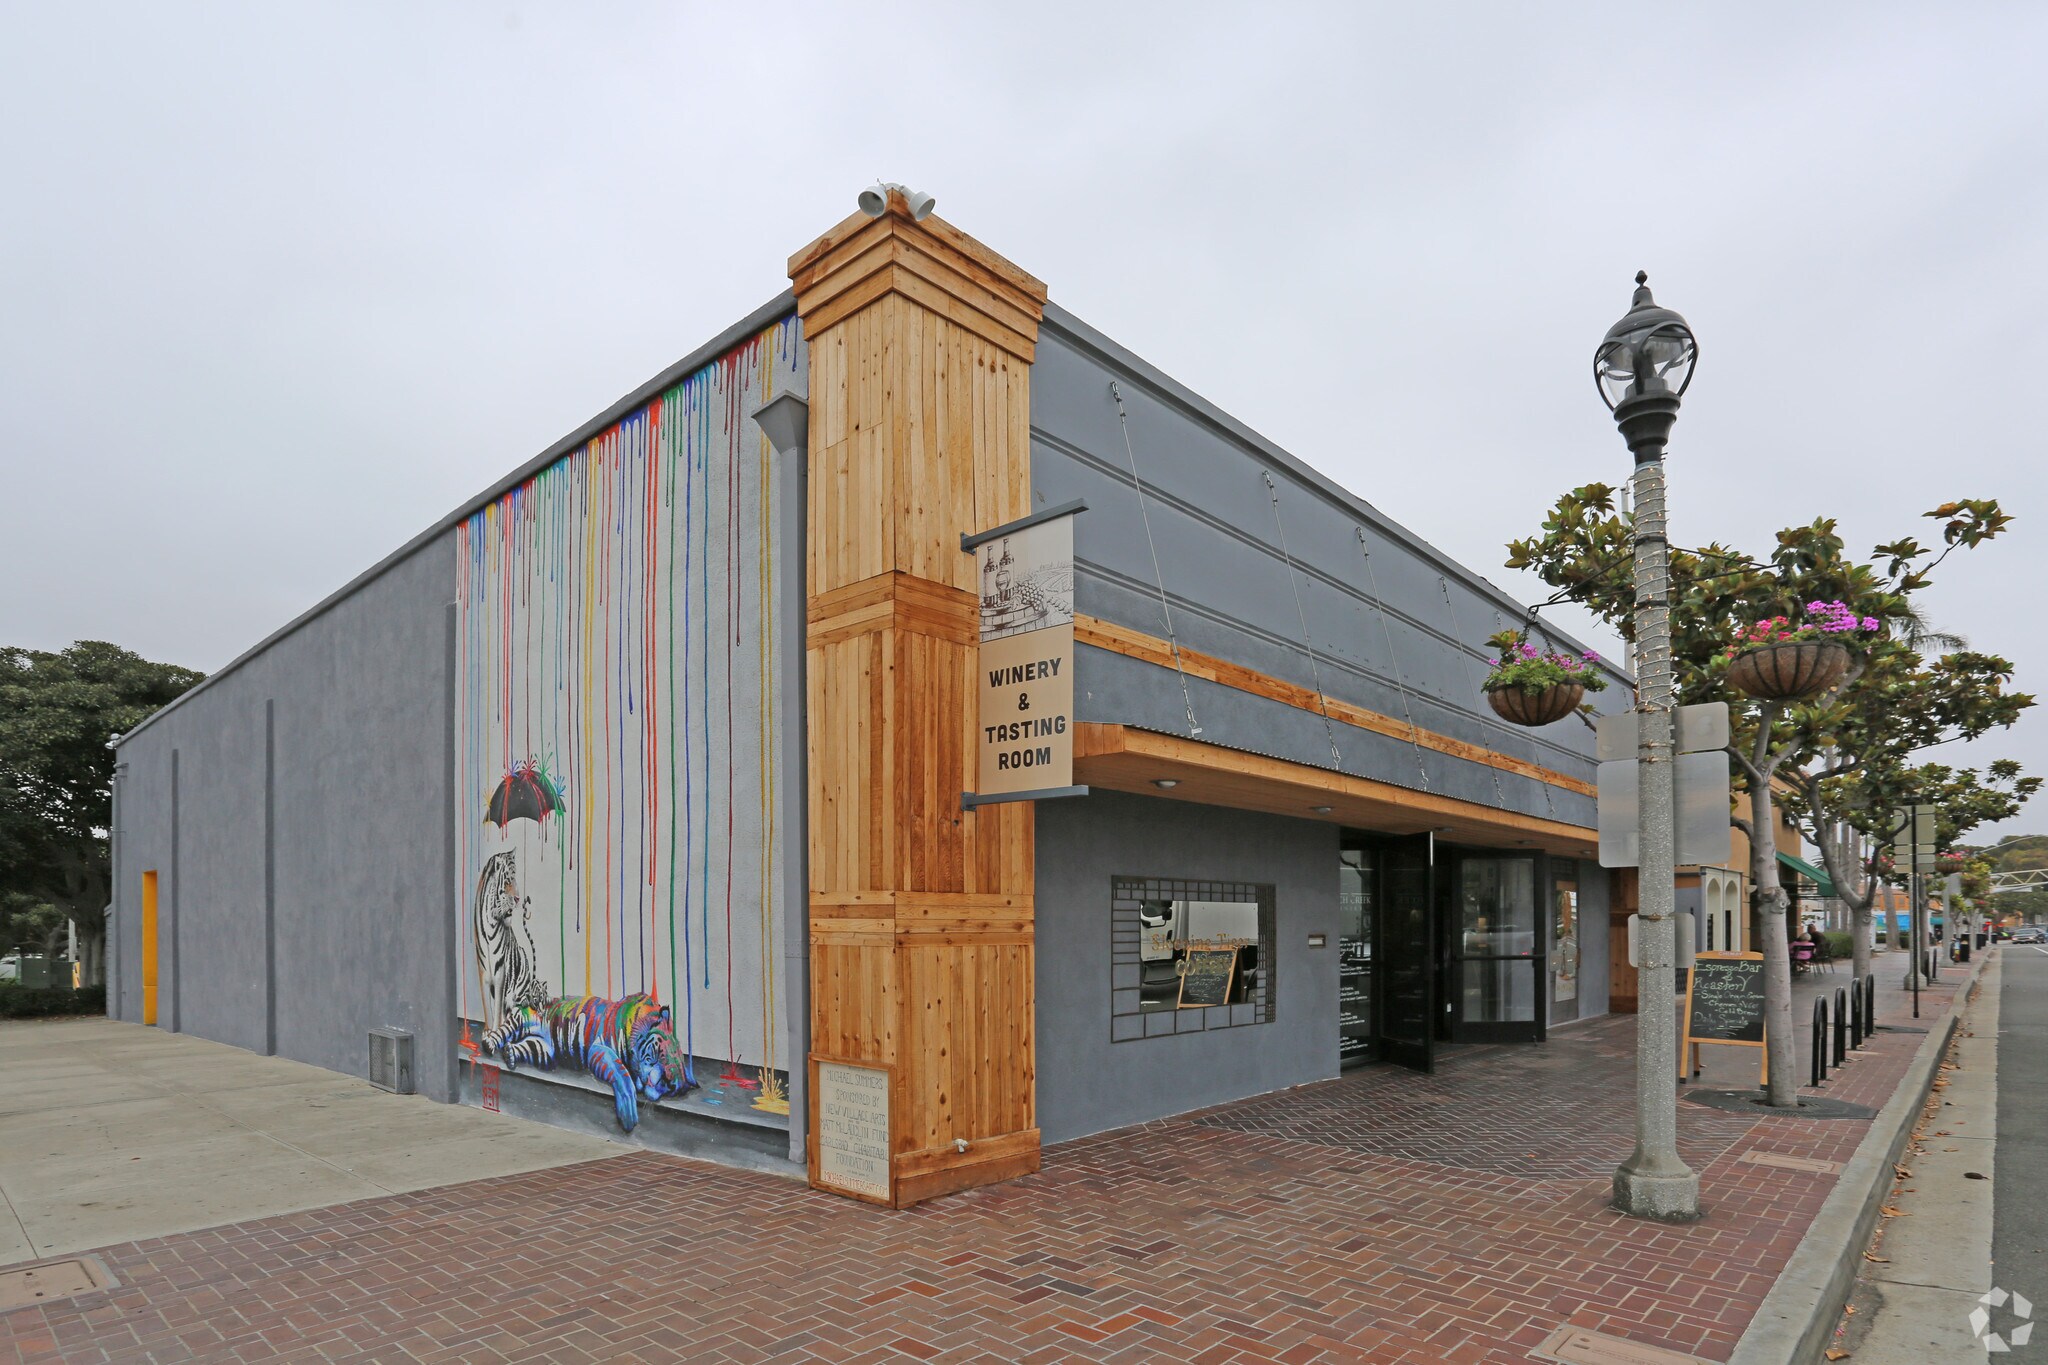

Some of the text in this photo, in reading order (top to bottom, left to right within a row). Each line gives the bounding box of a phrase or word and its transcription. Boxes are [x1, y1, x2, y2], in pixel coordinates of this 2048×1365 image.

[989, 657, 1062, 688] WINERY
[1018, 692, 1030, 711] &
[985, 715, 1066, 744] TASTING
[998, 746, 1051, 770] ROOM
[1350, 895, 1371, 904] CREEK
[1739, 961, 1762, 972] Bar
[827, 1069, 883, 1090] MICHAEL SUMMERS
[836, 1088, 880, 1109] SPONSORED BY
[825, 1103, 841, 1116] NEW
[842, 1105, 869, 1123] VILLAGE
[871, 1112, 886, 1126] ARTS
[820, 1135, 849, 1151] CARLSBAD
[835, 1152, 874, 1172] FOUNDATION
